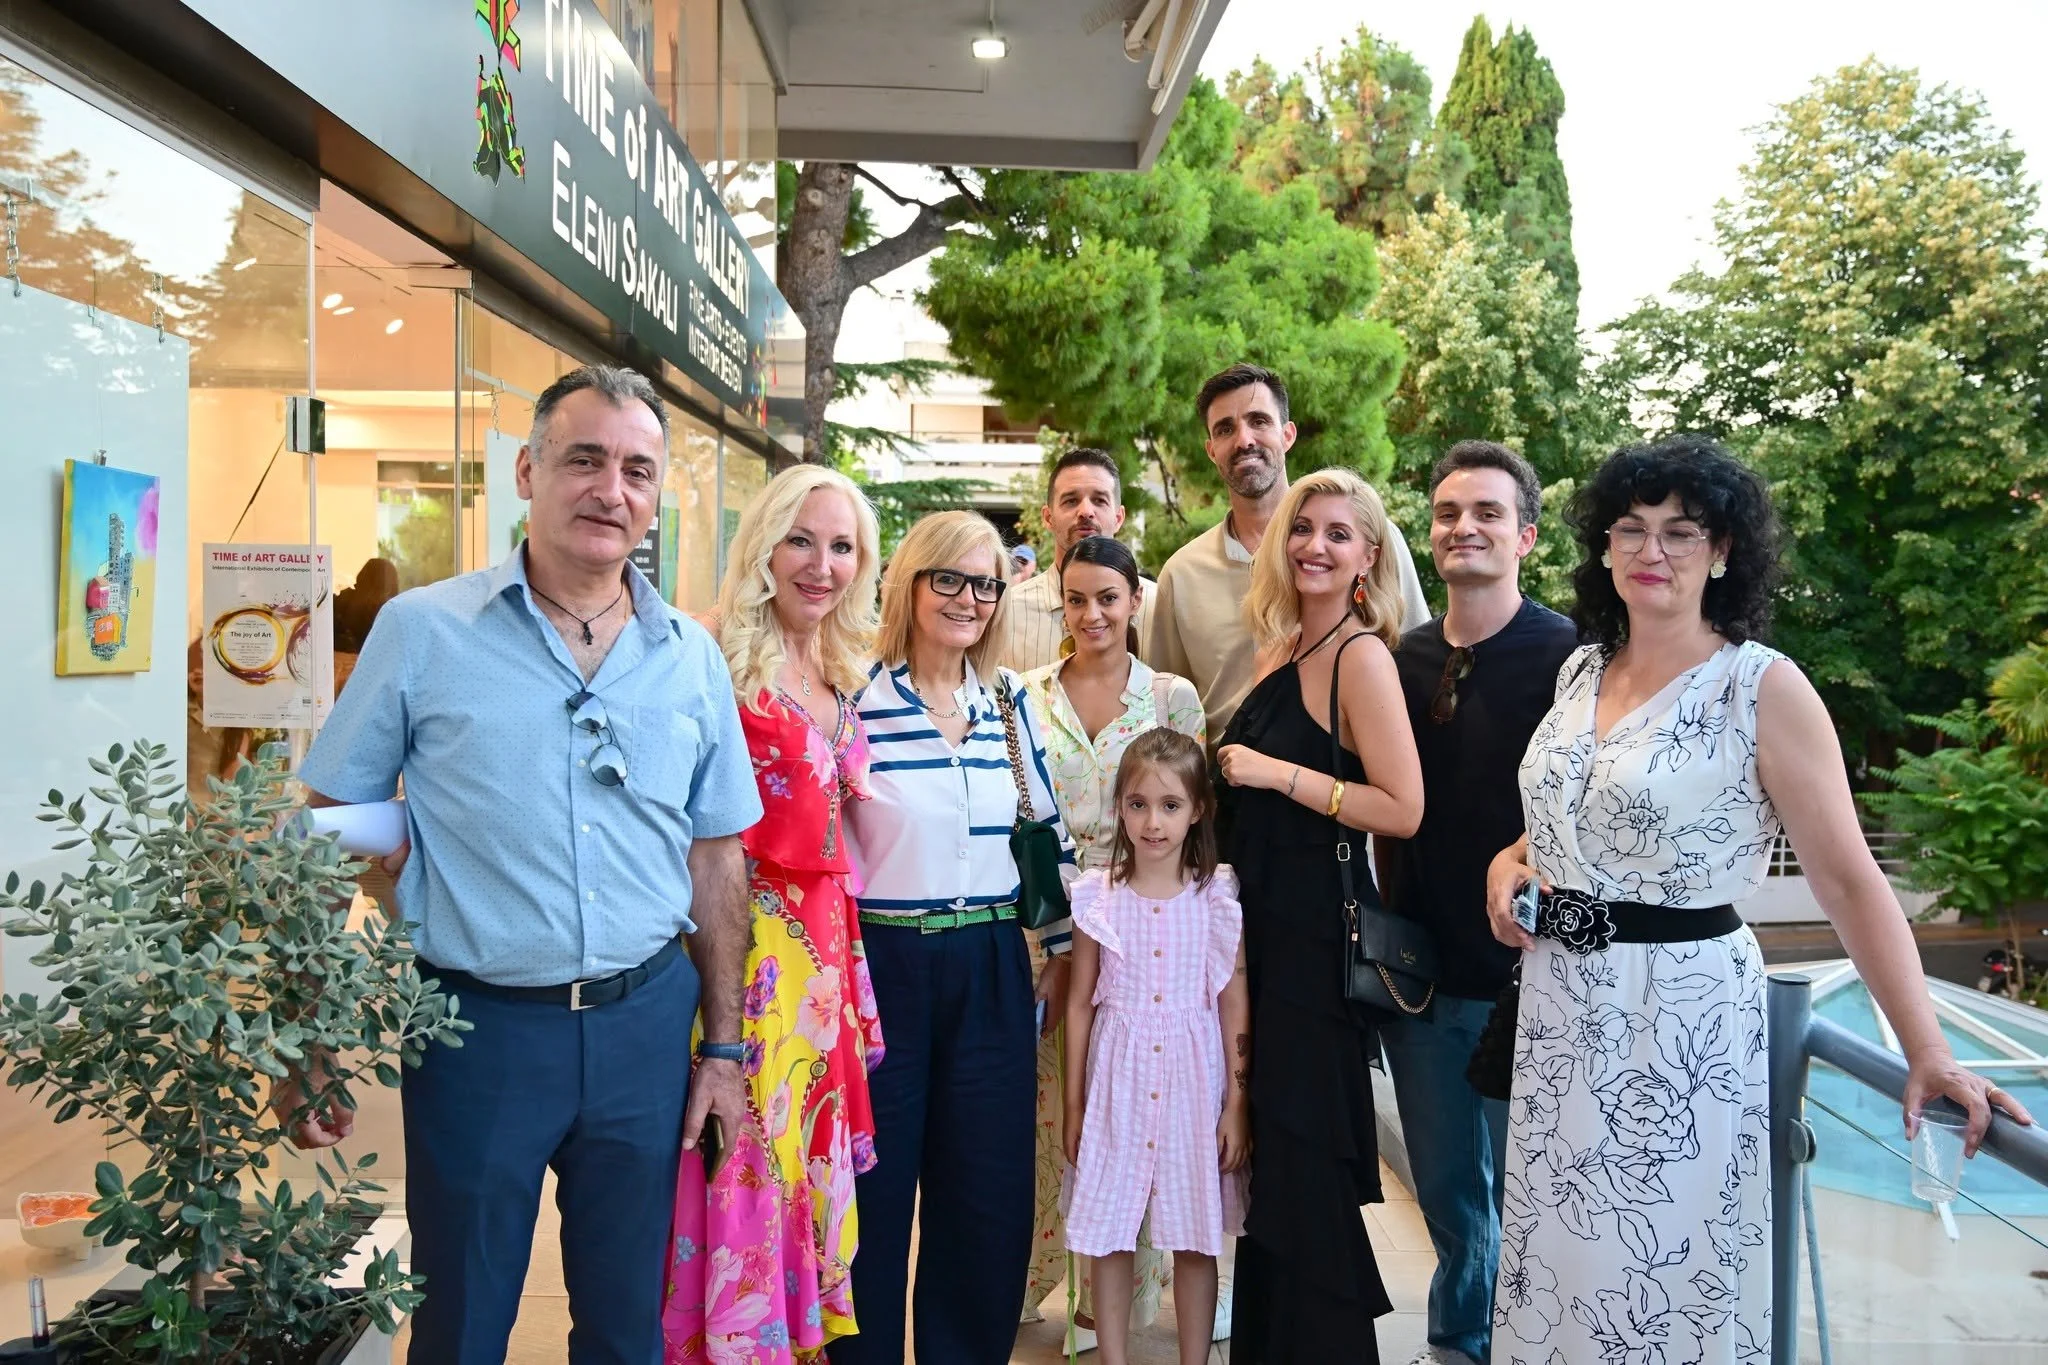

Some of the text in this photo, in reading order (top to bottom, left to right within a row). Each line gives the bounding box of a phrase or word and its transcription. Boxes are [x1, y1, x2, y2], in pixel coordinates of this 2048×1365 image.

[545, 0, 751, 320] TIME of ART GALLERY
[552, 140, 679, 335] ELENI SAKALI
[212, 552, 324, 564] TIME of ART GALLEY
